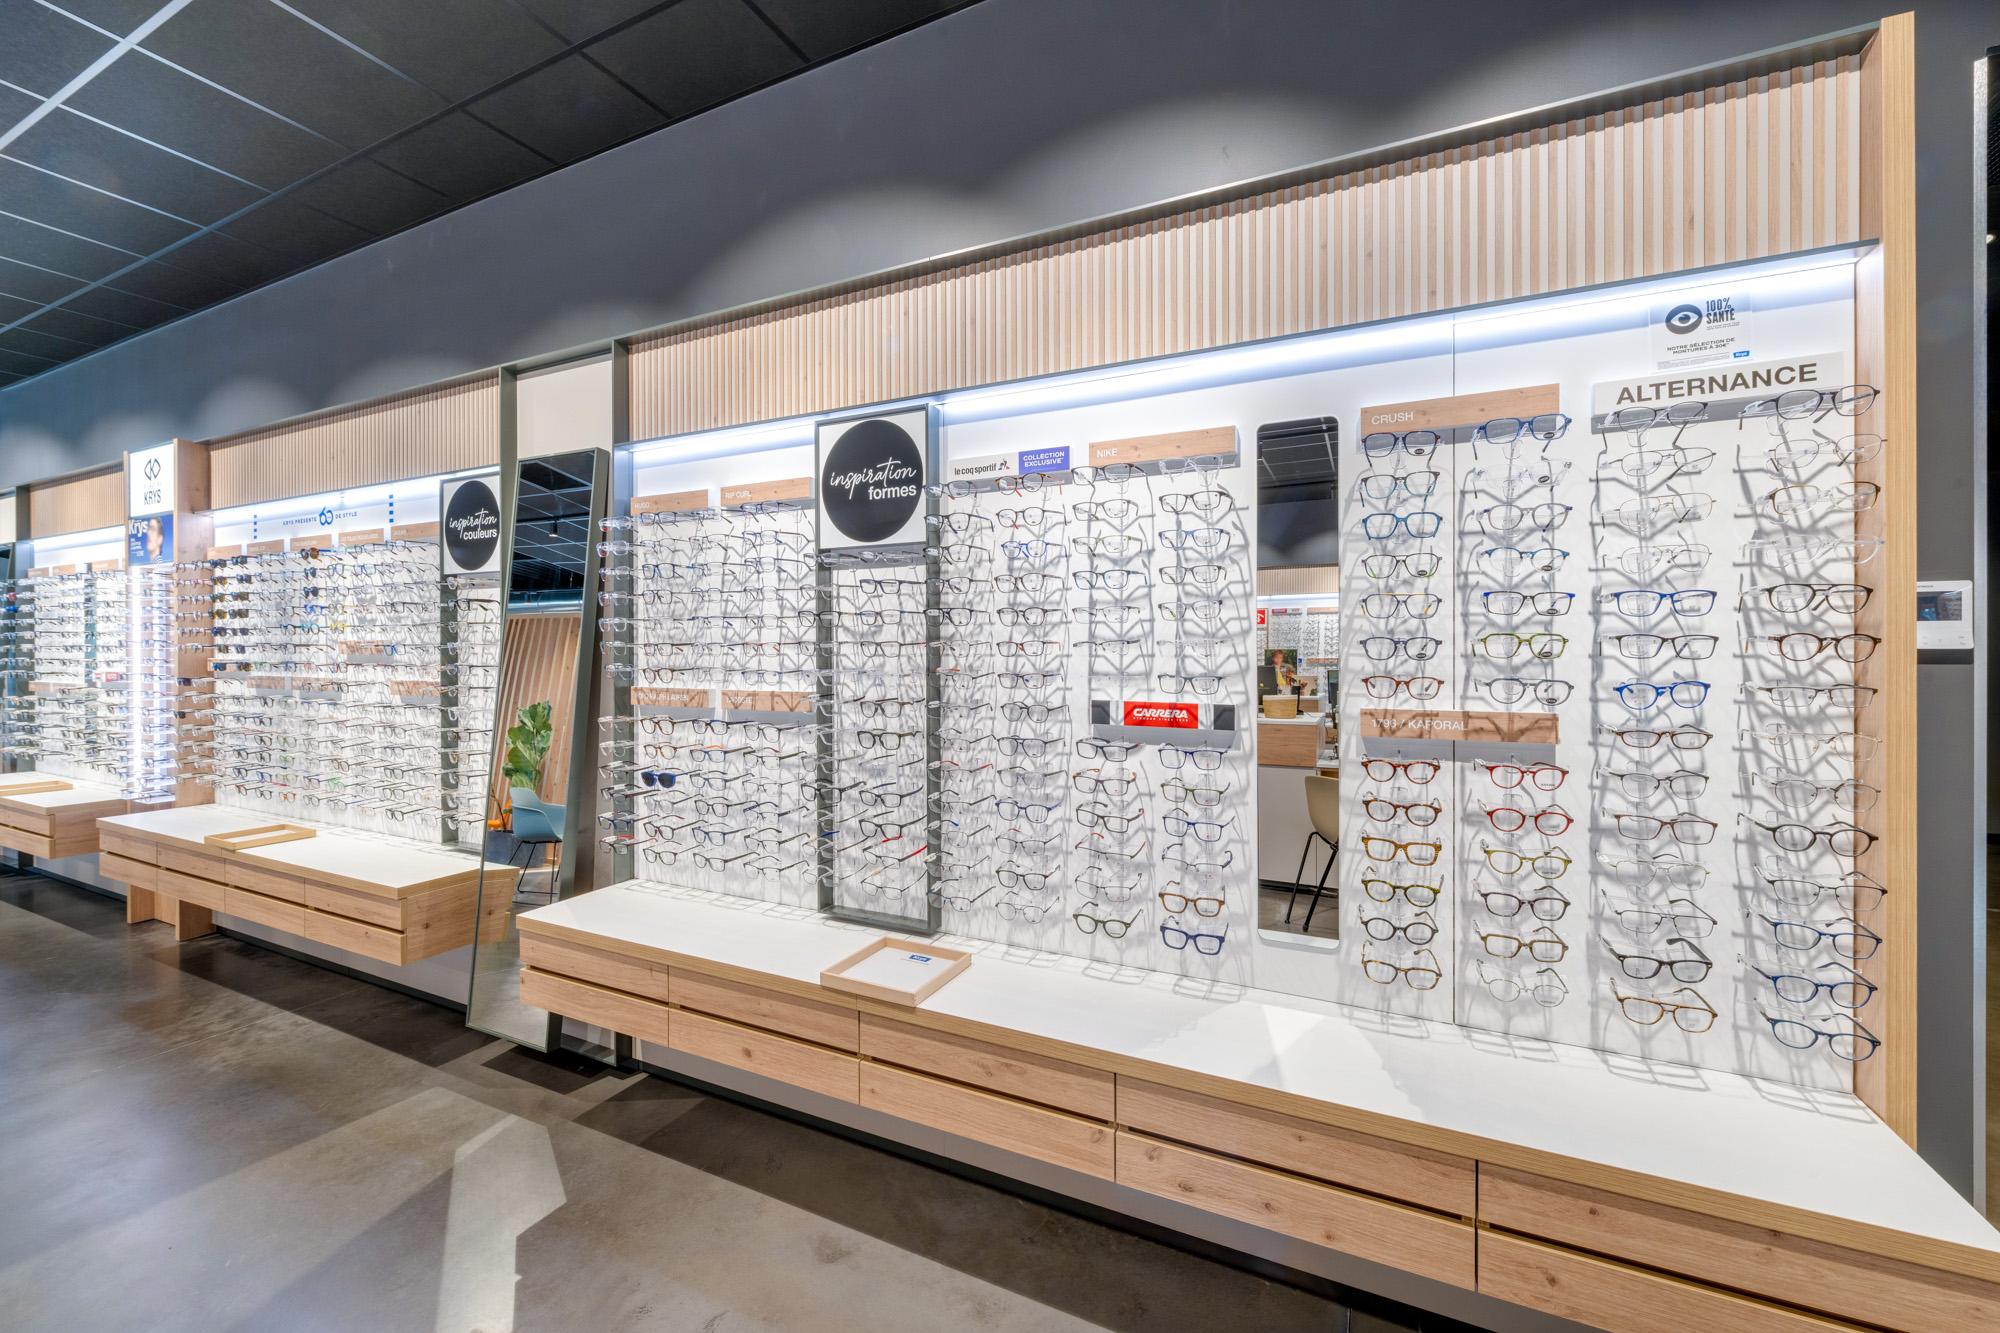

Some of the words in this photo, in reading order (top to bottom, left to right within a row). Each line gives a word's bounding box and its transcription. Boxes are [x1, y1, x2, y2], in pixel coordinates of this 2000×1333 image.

[1706, 297, 1732, 312] 100%
[1706, 308, 1736, 325] SANTÉ
[1616, 363, 1818, 406] ALTERNANCE
[1371, 412, 1414, 425] CRUSH
[1023, 451, 1065, 462] COLLECTION
[1096, 448, 1118, 459] NIKE
[954, 468, 961, 476] le
[961, 467, 974, 475] coq
[974, 462, 997, 475] sportif
[830, 456, 917, 500] inspiration
[143, 489, 162, 506] KRYS
[868, 484, 918, 501] formes
[128, 519, 149, 537] Krys
[449, 507, 498, 539] inspiration
[463, 528, 498, 541] couleurs
[1133, 708, 1189, 719] CARRERA
[1408, 719, 1468, 731] KAPORAL
